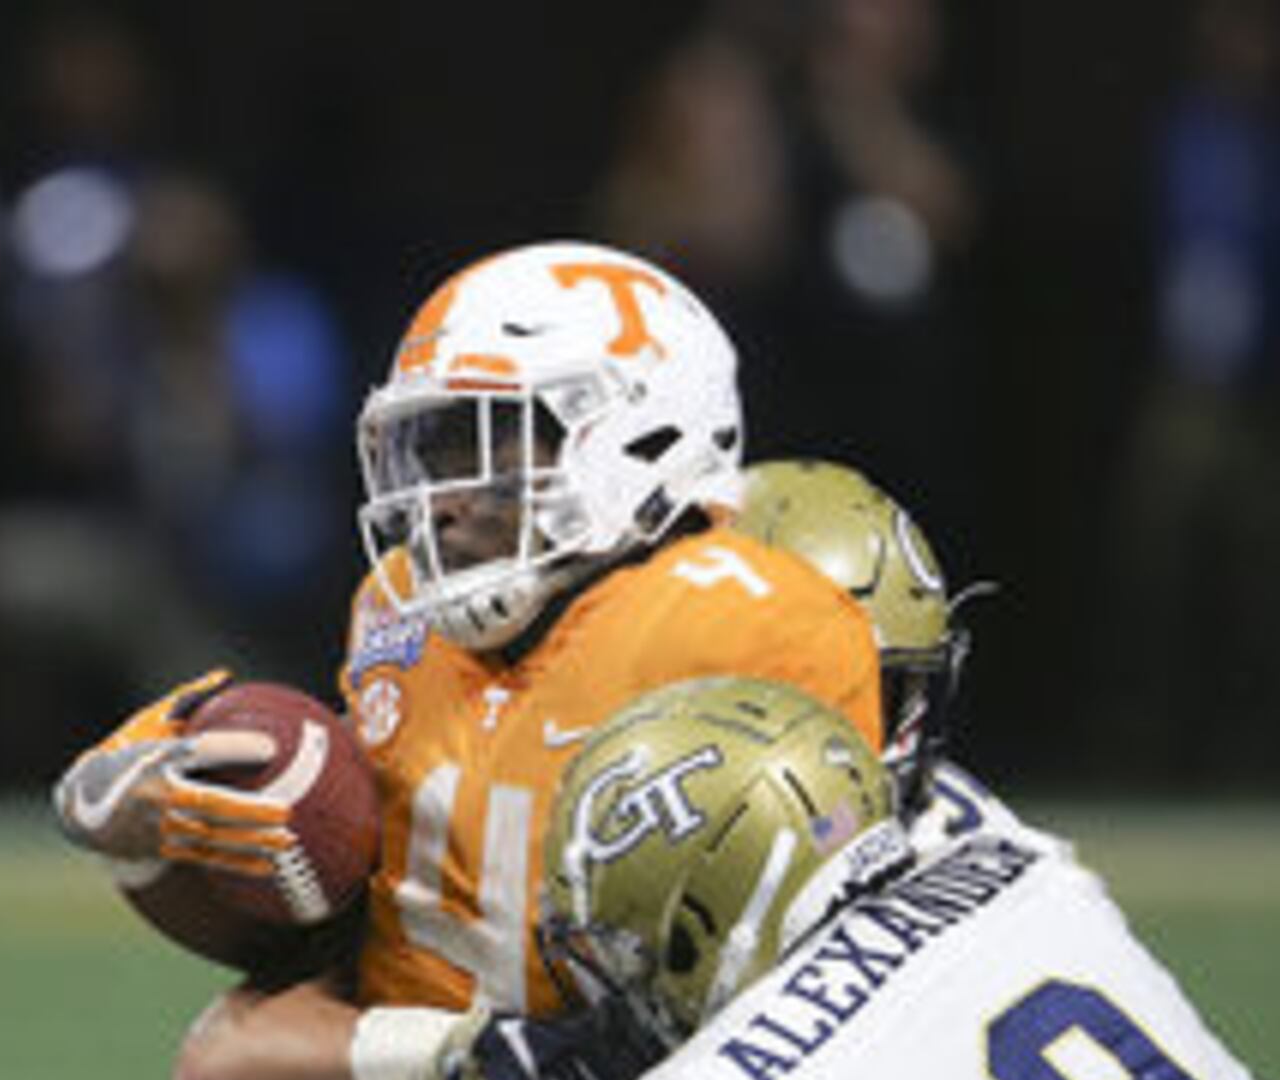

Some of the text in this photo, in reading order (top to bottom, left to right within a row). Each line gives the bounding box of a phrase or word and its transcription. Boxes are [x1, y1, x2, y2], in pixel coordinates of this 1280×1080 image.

[549, 263, 668, 360] T
[670, 547, 773, 596] 4
[572, 743, 724, 864] GT
[395, 763, 533, 1015] 4
